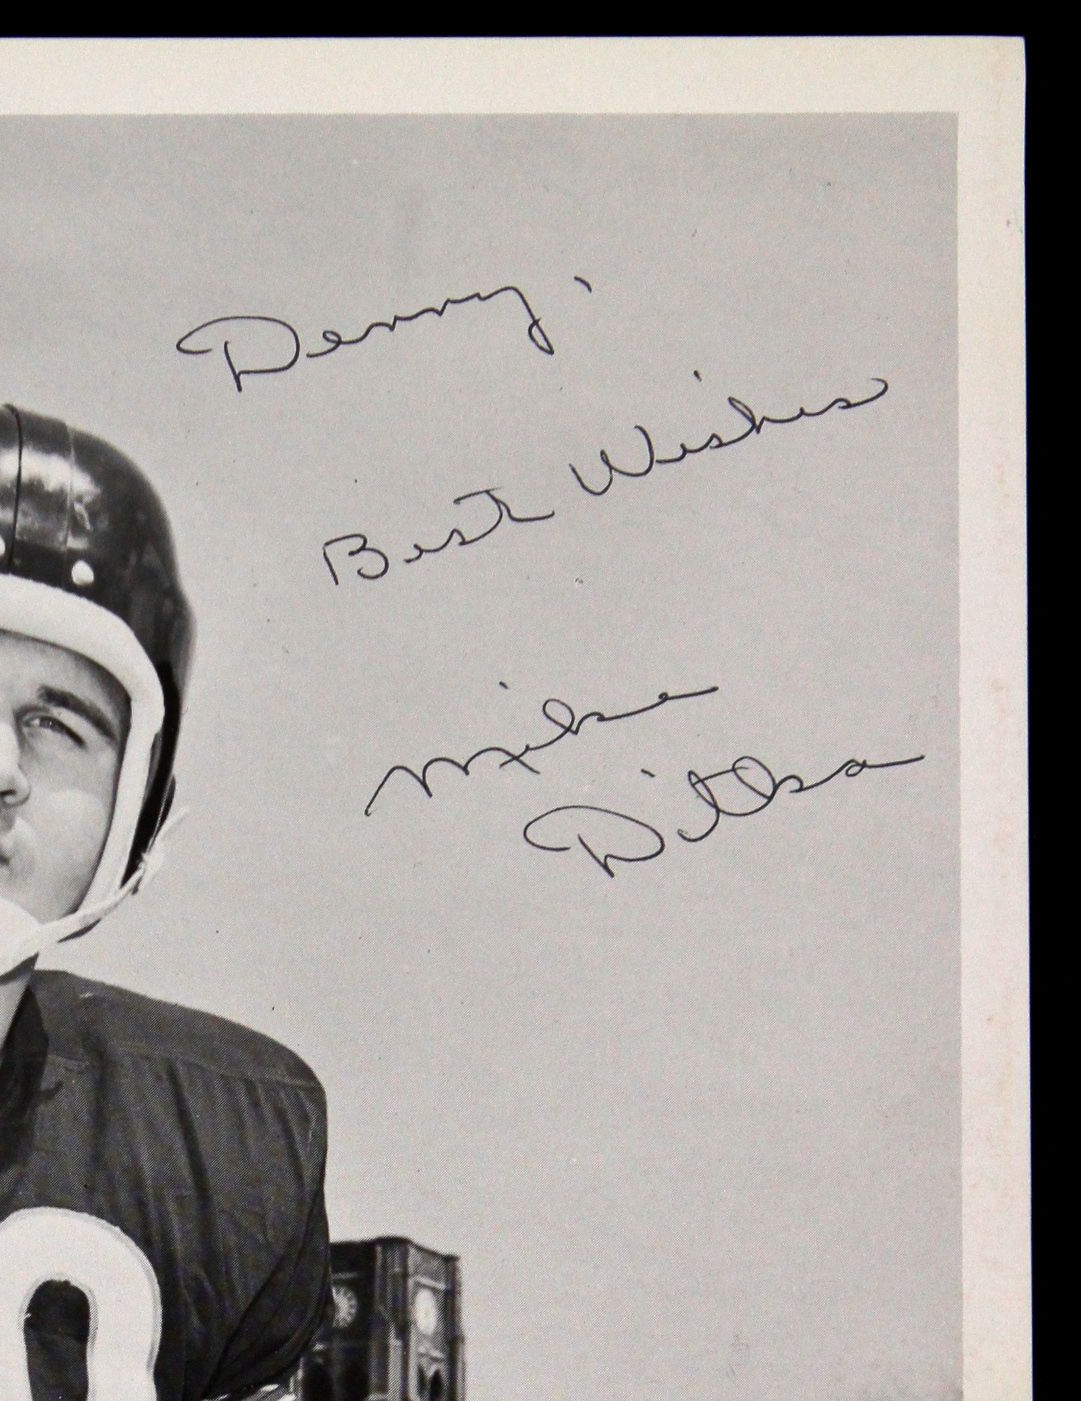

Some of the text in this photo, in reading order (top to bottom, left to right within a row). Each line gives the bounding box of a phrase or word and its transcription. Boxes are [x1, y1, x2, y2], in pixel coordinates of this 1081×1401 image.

[322, 370, 889, 586] Best Wishes
[365, 682, 720, 817] Mike
[523, 755, 926, 879] Ditka
